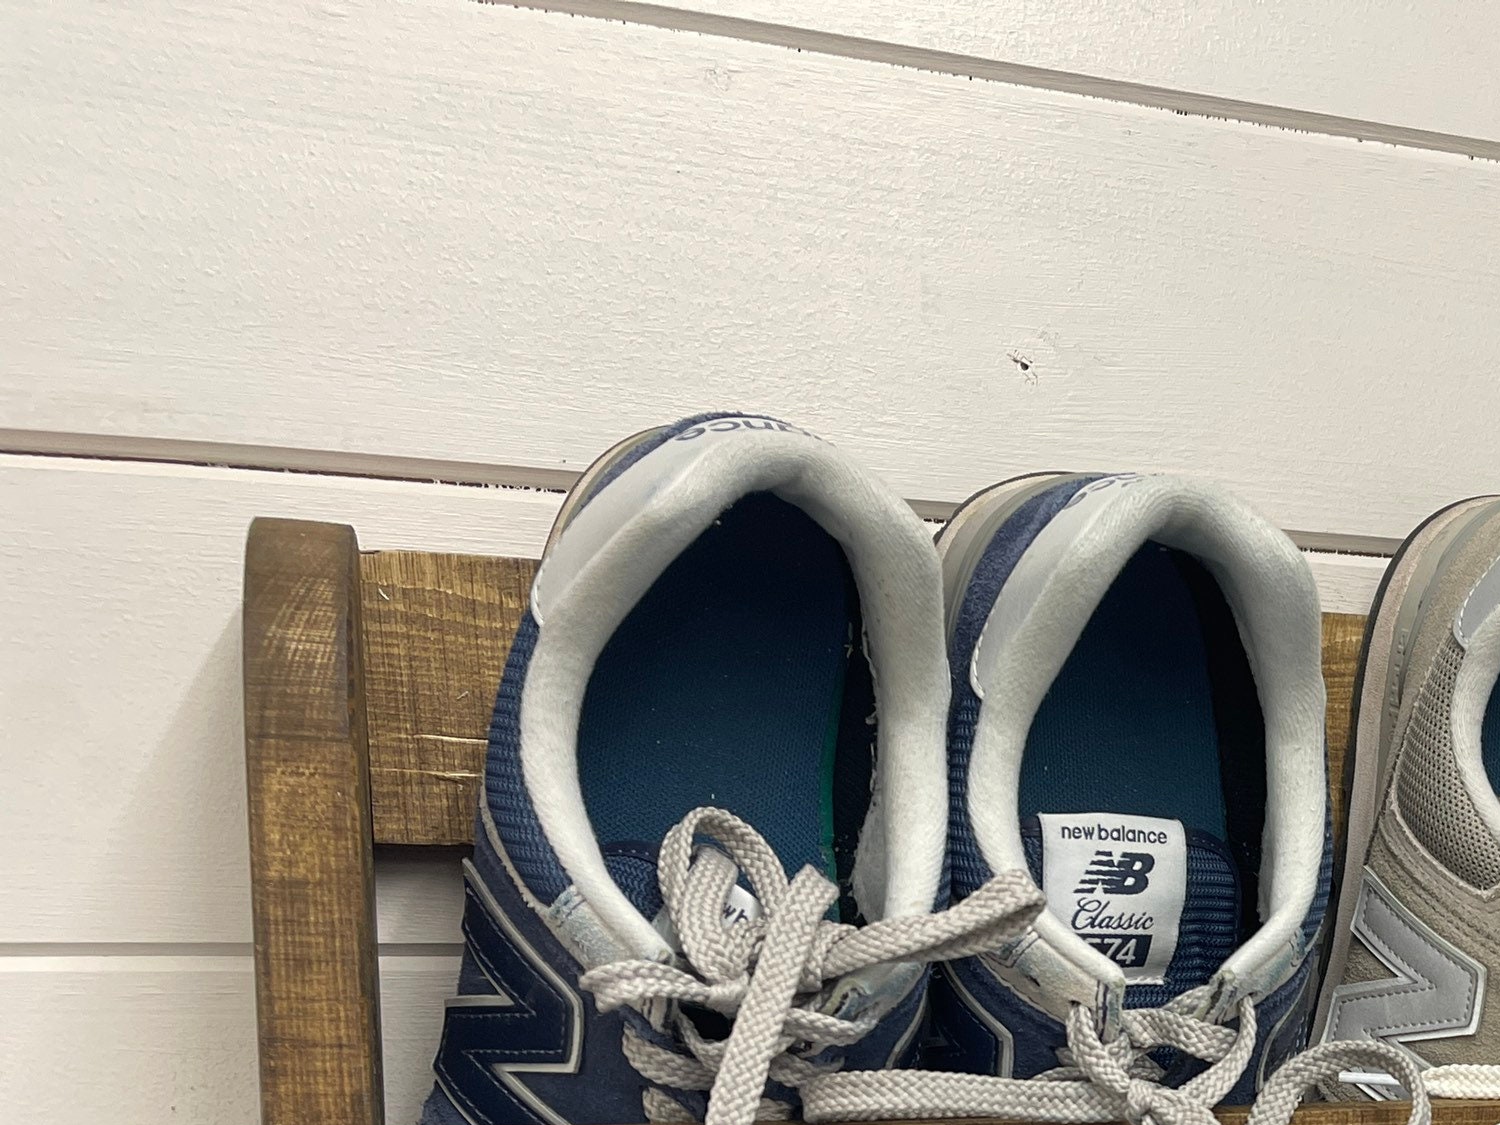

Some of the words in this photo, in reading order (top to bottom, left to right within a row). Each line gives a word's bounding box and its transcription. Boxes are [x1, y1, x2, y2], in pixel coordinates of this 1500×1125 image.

[1060, 825, 1095, 841] new
[1097, 824, 1168, 845] balance
[1071, 897, 1155, 931] Classic
[1086, 937, 1138, 965] 74
